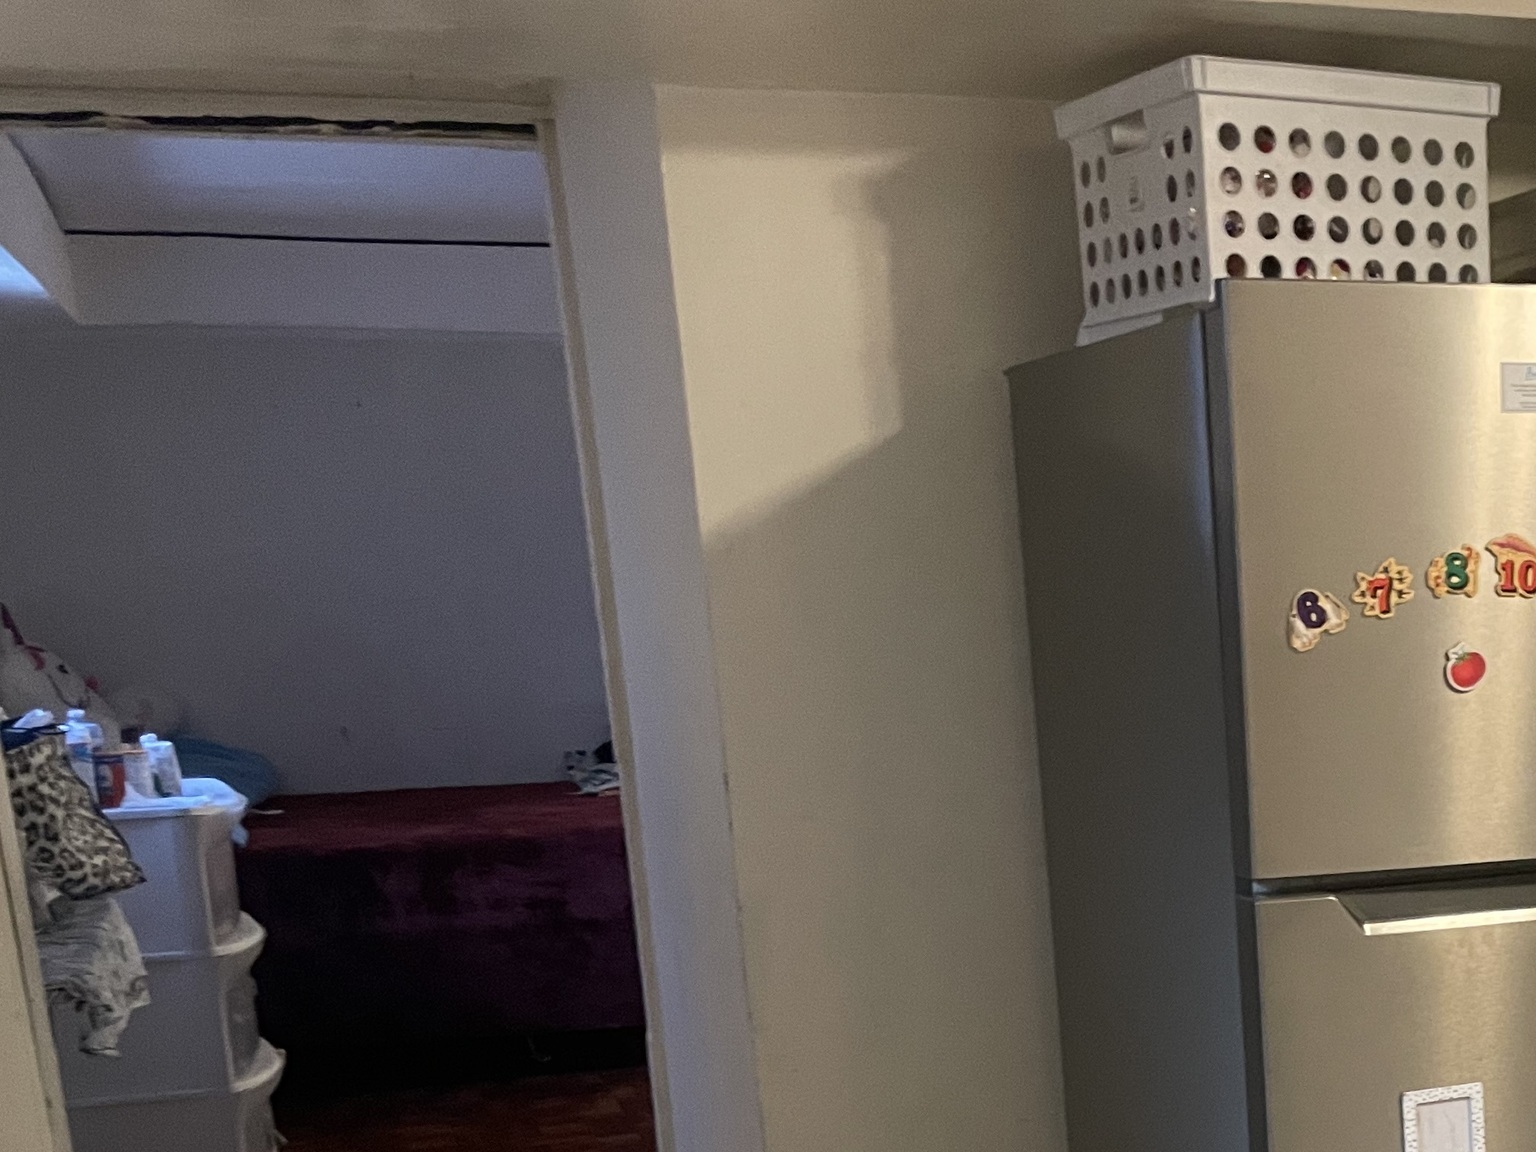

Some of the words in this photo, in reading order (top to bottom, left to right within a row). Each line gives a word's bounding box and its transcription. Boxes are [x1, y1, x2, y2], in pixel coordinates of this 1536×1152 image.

[1444, 552, 1469, 591] 8
[1297, 591, 1327, 629] 6
[1367, 576, 1393, 615] 7
